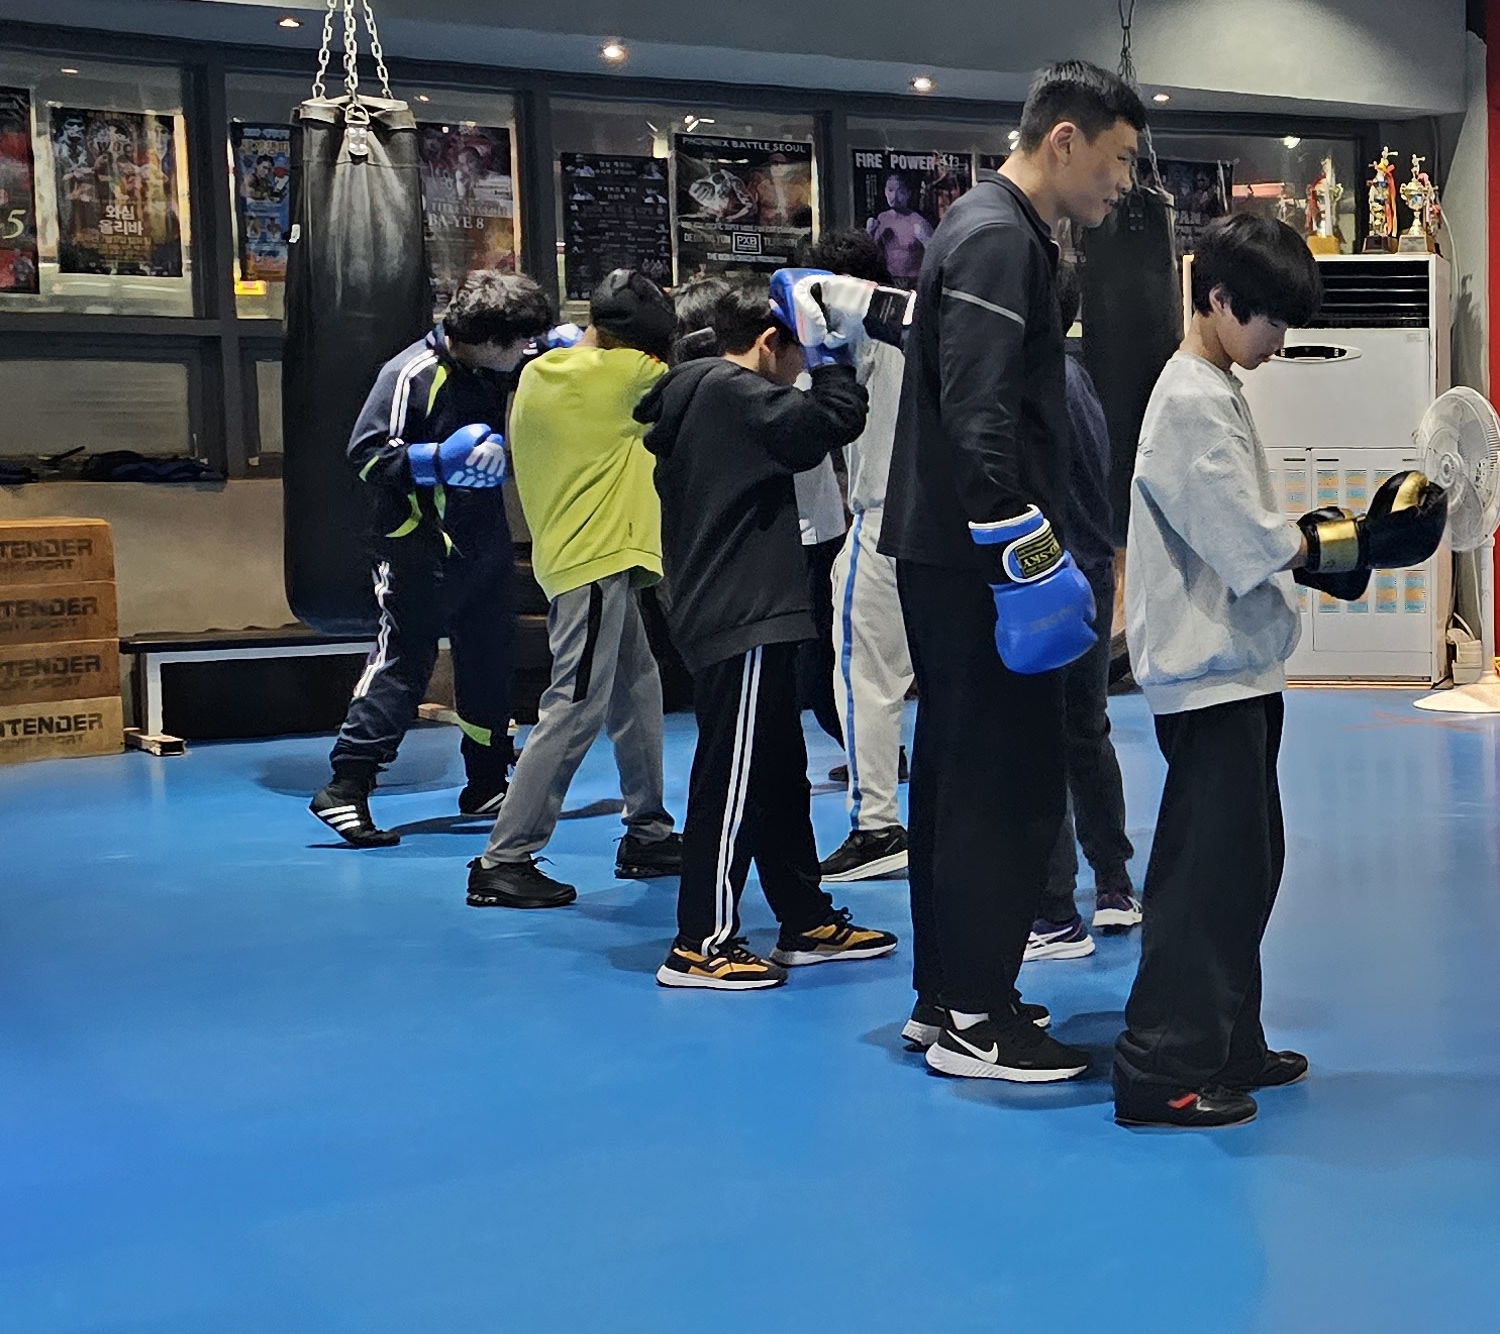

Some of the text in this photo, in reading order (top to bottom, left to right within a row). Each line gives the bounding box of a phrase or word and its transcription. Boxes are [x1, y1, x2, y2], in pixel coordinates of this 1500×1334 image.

[731, 141, 771, 151] BATTLE
[772, 142, 806, 153] SEOUL
[855, 152, 883, 168] FIRE
[890, 154, 935, 170] POWER
